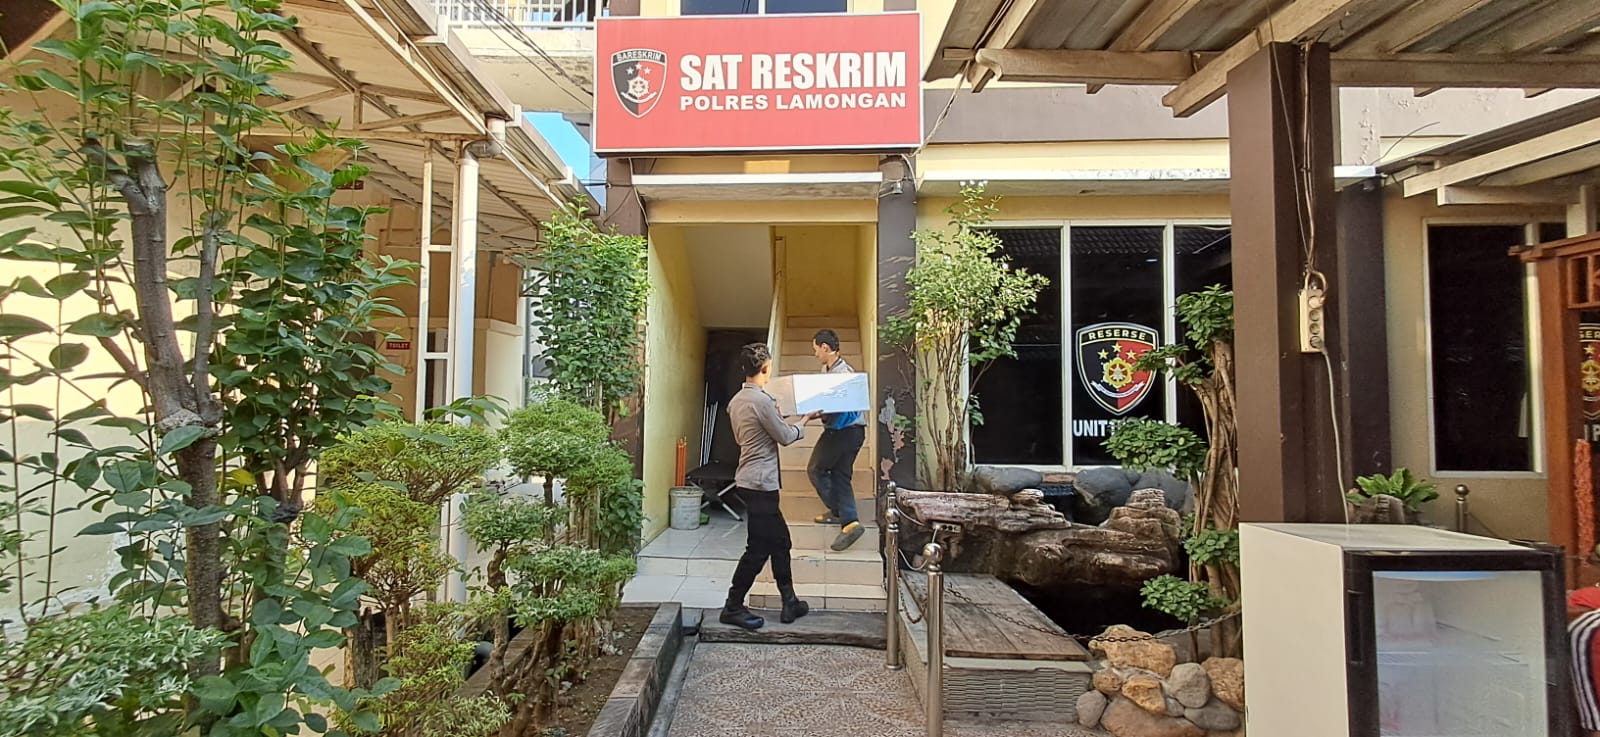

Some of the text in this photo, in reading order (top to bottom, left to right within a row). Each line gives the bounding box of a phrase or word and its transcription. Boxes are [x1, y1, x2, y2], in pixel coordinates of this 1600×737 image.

[616, 50, 662, 62] BARESKRIM
[680, 51, 906, 91] SAT RESKRIM
[680, 92, 906, 111] POLRES LAMONGAN
[1088, 329, 1146, 340] RESERSE
[1073, 419, 1108, 437] UNIT
